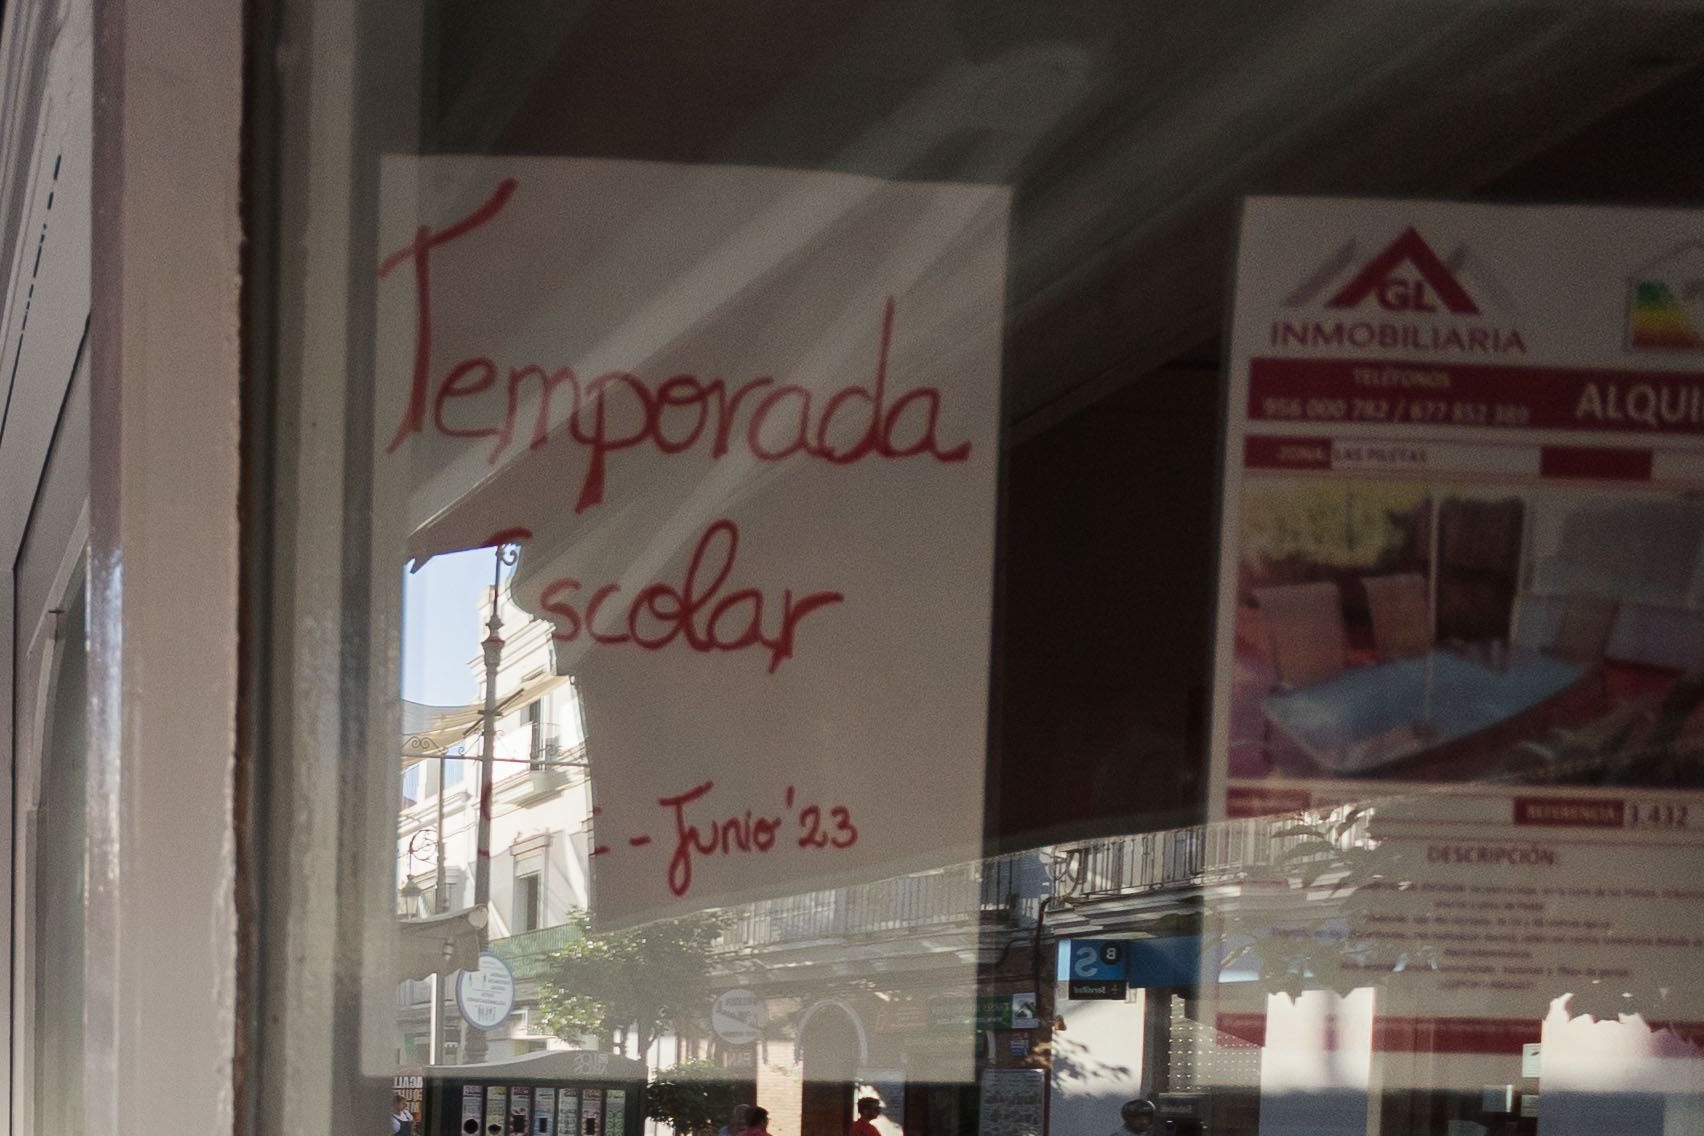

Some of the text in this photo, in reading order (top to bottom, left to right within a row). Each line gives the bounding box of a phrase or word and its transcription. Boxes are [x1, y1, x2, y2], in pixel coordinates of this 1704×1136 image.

[1270, 320, 1529, 354] INMOBILIARIA
[1378, 278, 1438, 314] GL
[380, 178, 973, 514] Temporada
[484, 518, 844, 673] scolar
